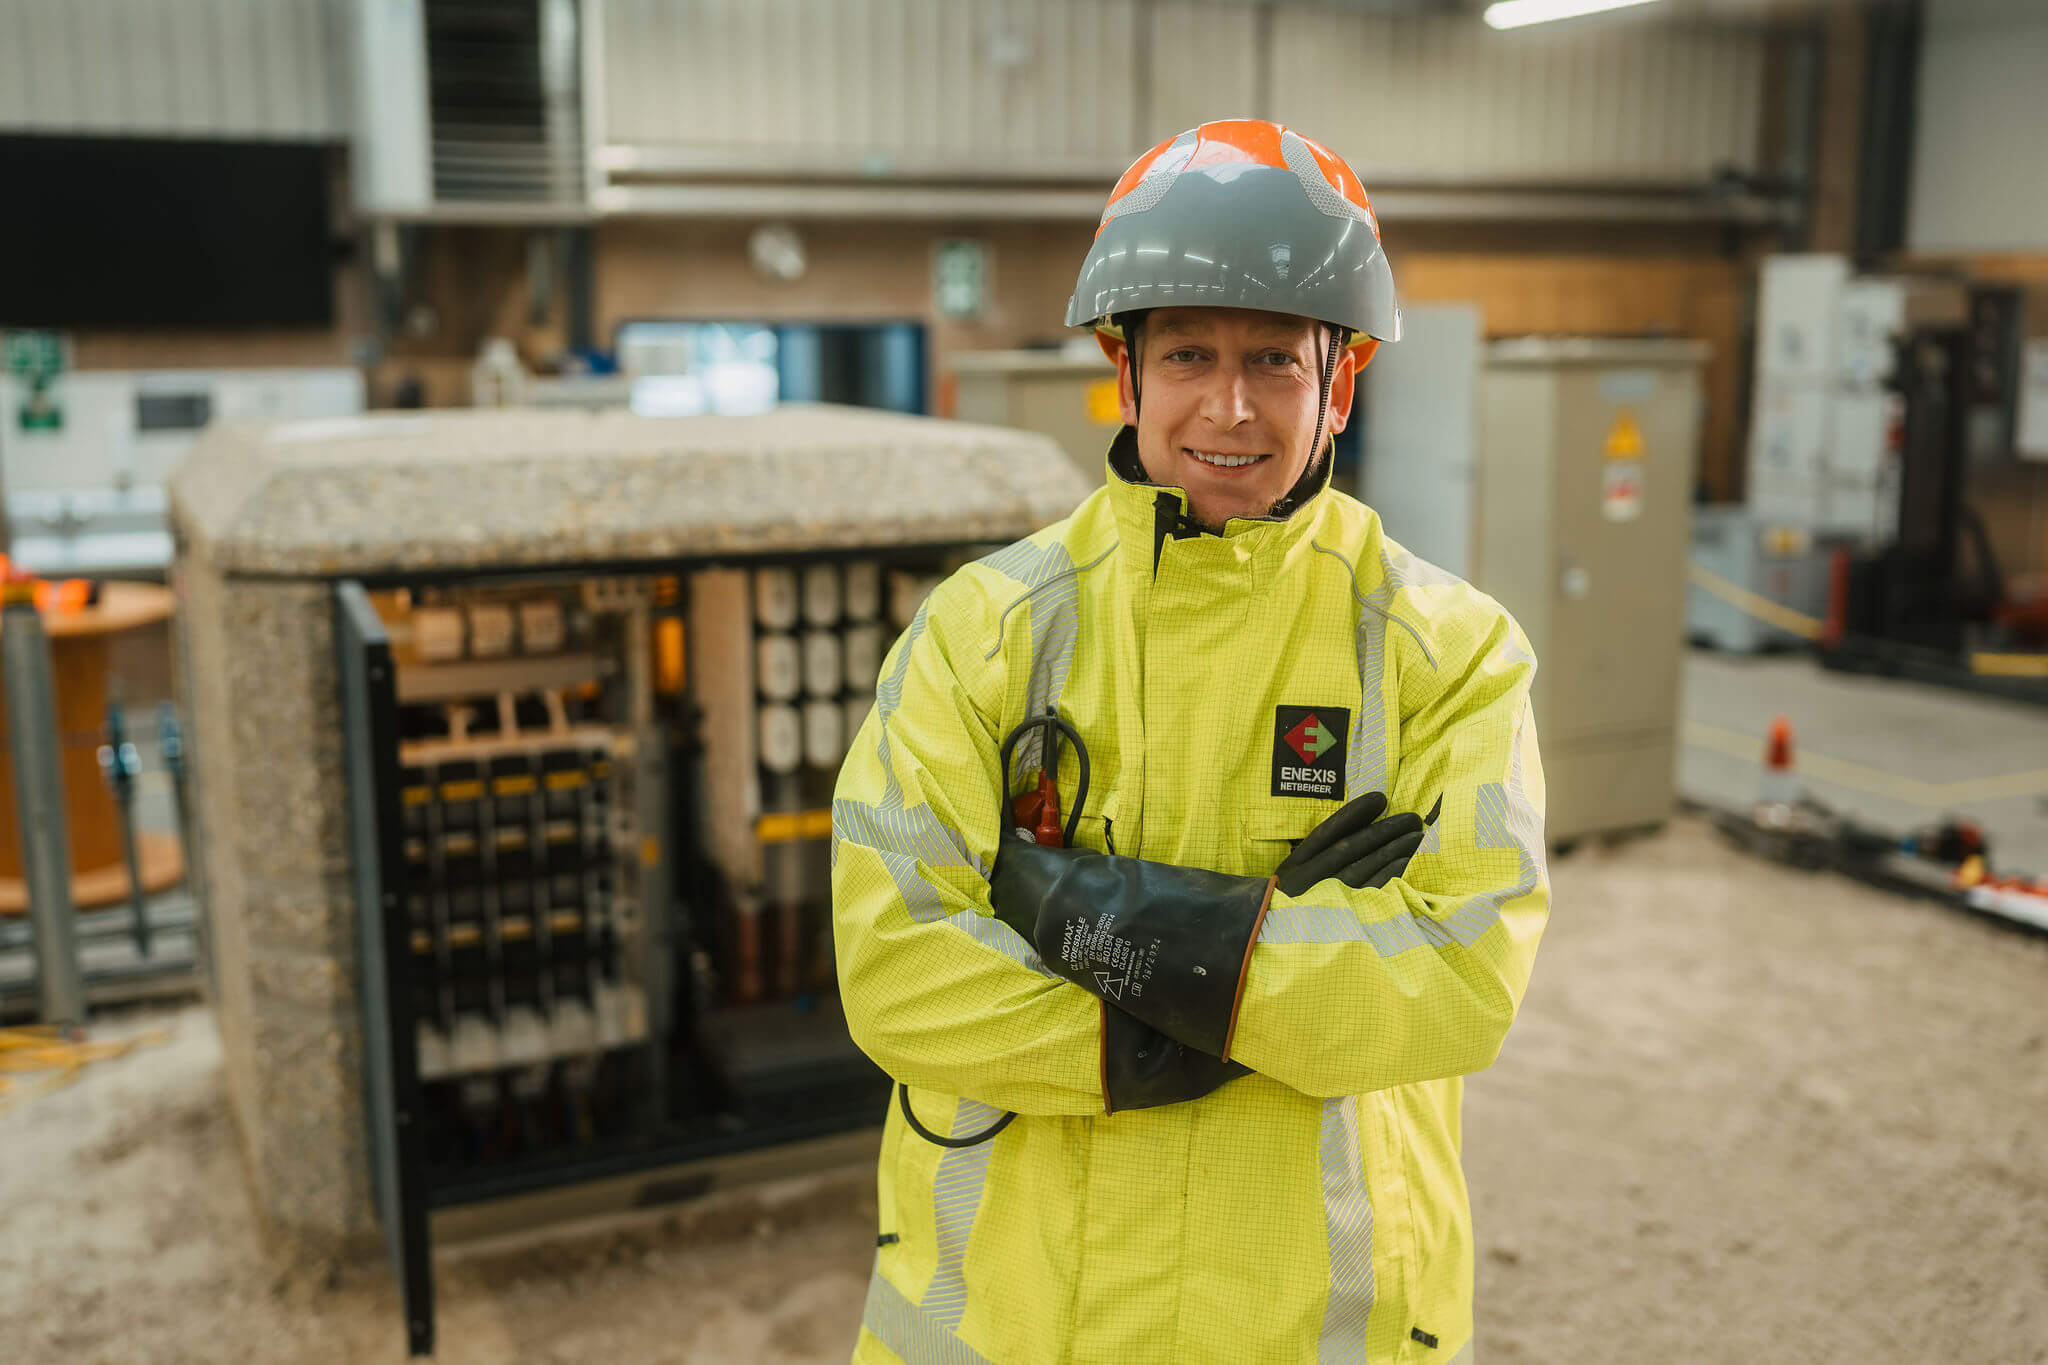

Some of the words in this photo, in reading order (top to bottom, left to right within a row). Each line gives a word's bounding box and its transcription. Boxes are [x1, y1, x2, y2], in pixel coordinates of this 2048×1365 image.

[1281, 766, 1336, 783] ENEXIS
[1280, 781, 1332, 794] NETBEHEER
[1070, 916, 1086, 971] CLYDESDALE
[1119, 946, 1130, 970] CLASS
